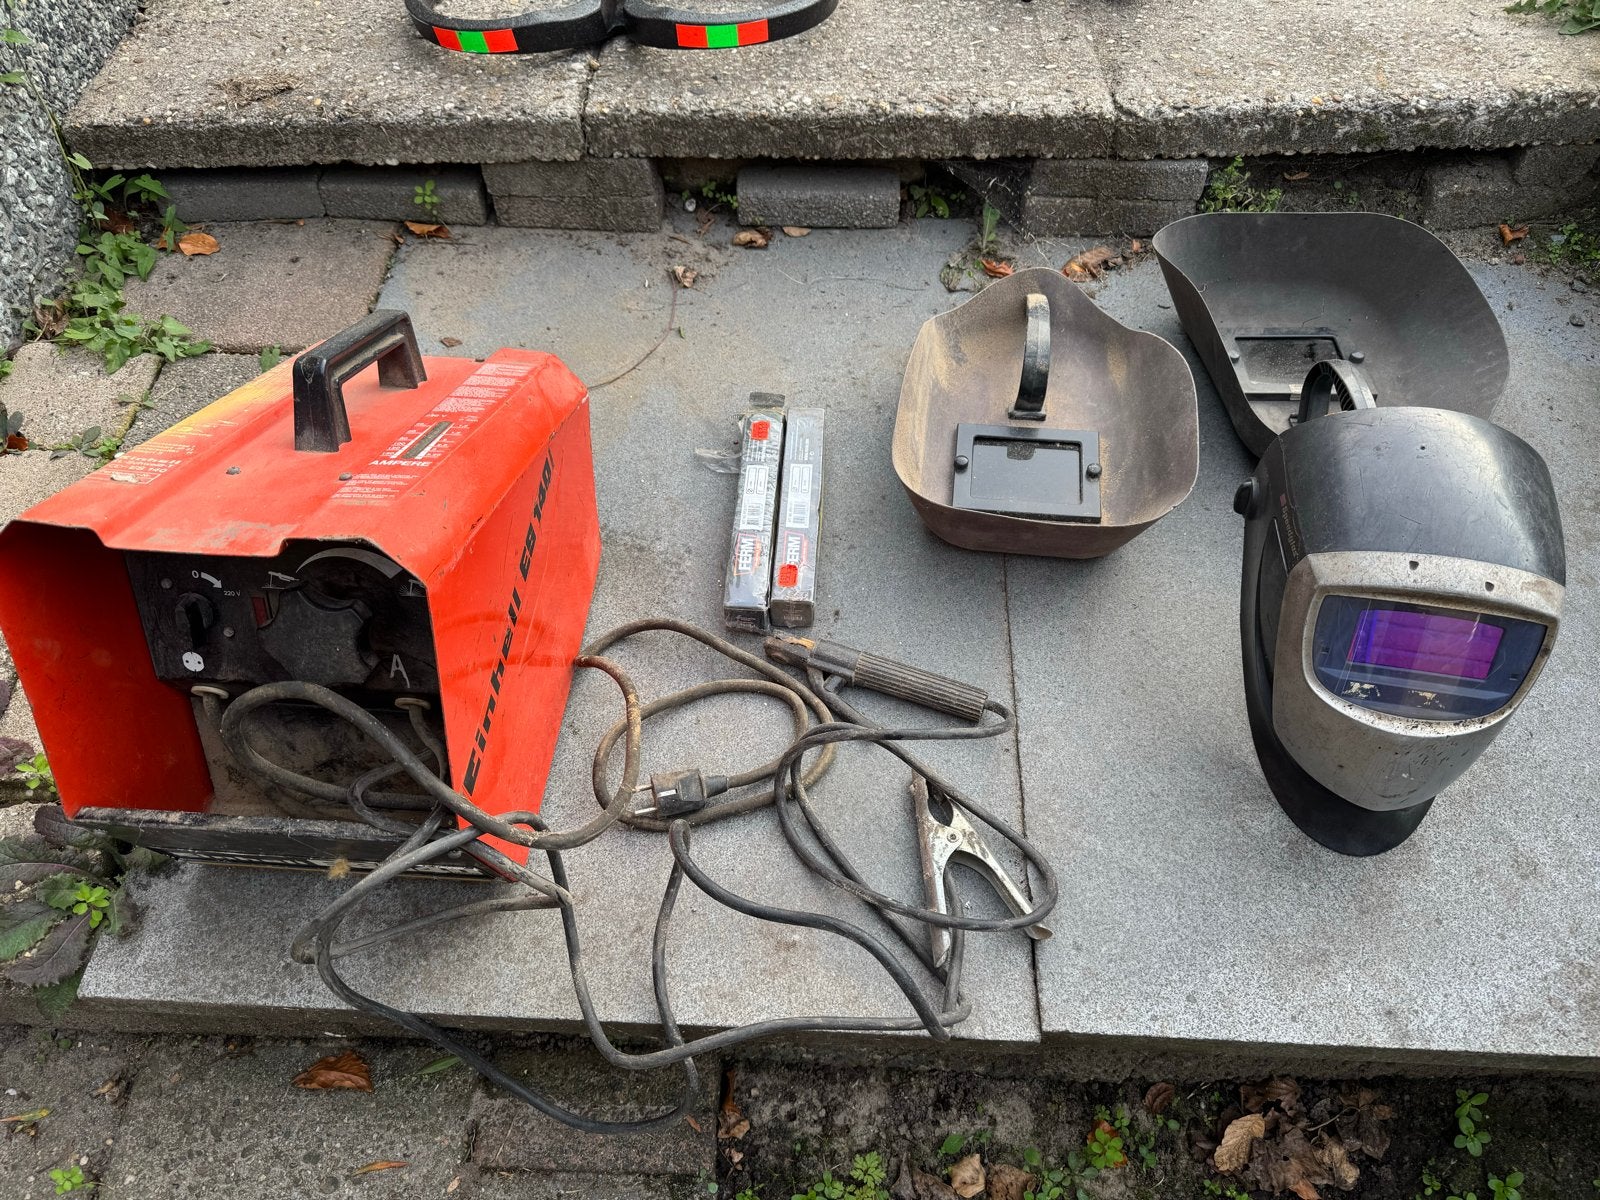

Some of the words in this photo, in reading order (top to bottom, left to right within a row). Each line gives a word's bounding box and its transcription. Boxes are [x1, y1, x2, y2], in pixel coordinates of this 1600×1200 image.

[738, 538, 755, 571] FERM
[390, 653, 410, 689] A
[463, 586, 521, 796] Einhell
[520, 522, 536, 582] EB
